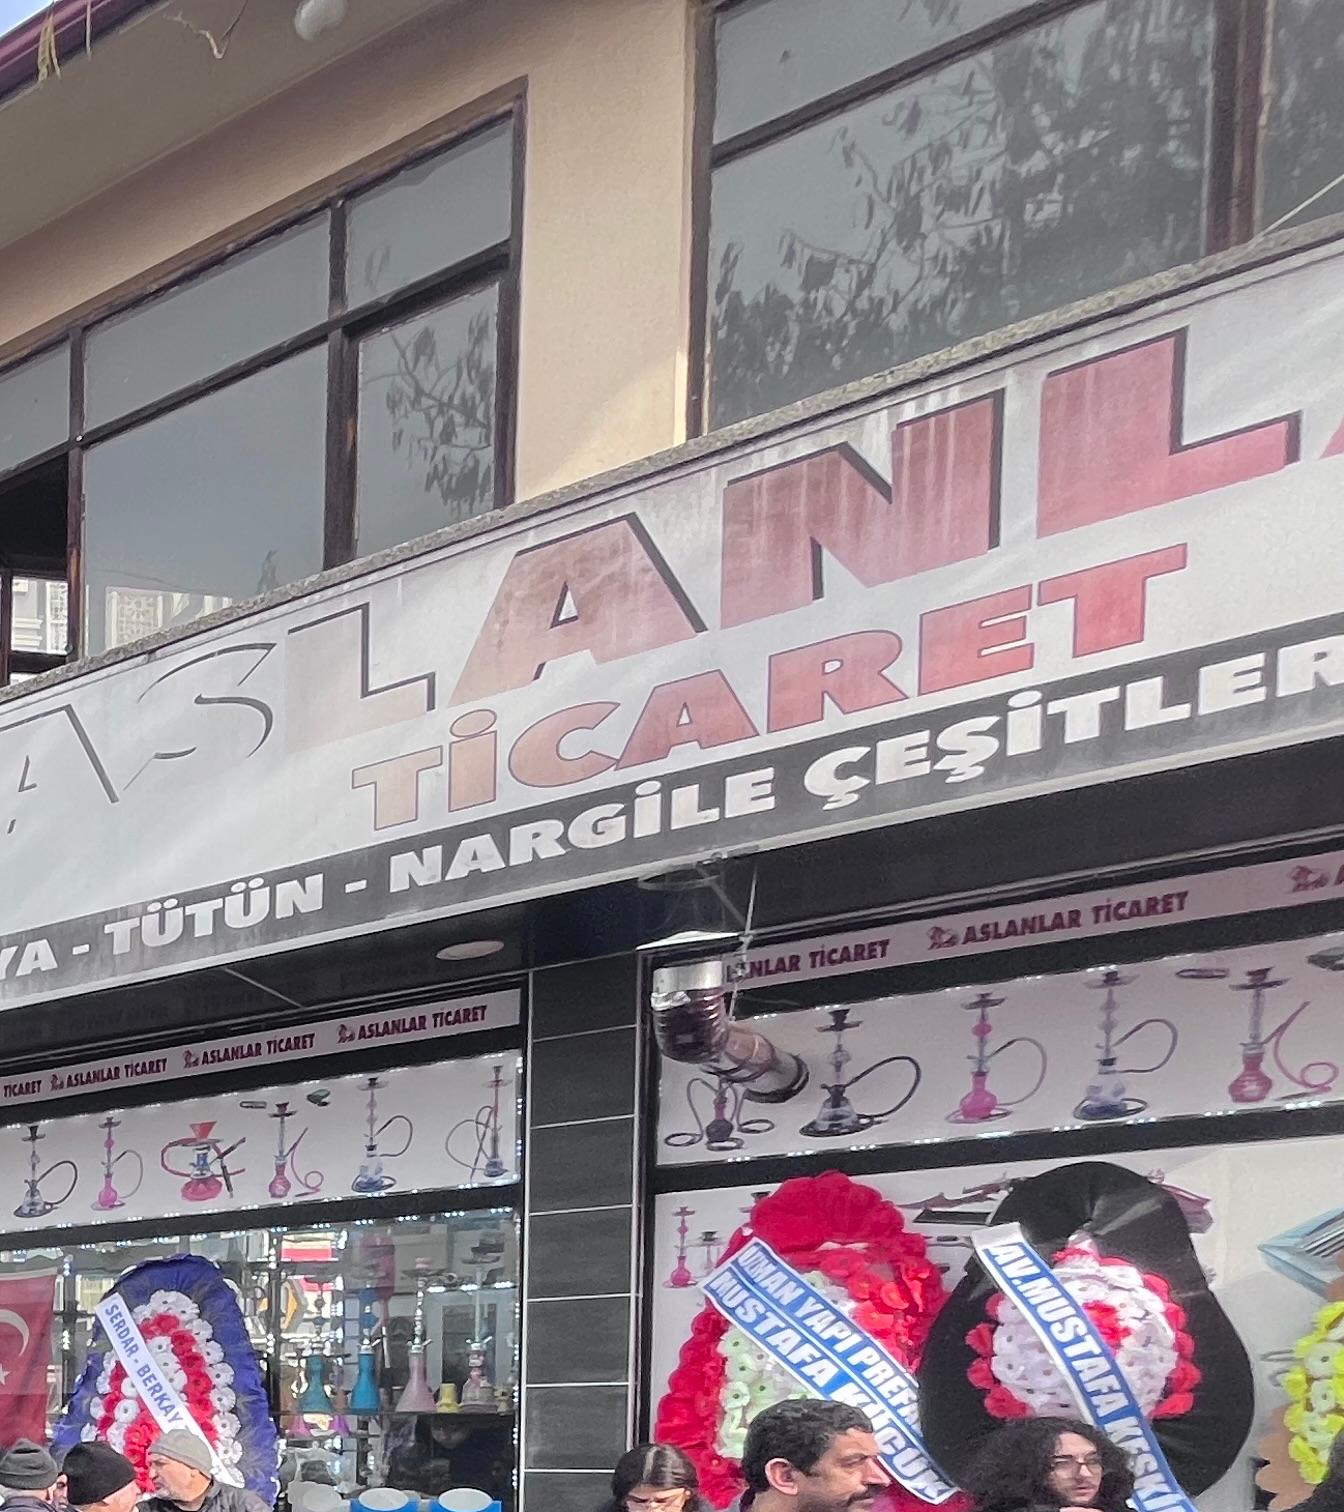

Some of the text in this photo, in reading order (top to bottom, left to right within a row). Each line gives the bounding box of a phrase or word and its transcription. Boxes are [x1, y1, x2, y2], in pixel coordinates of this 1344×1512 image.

[352, 542, 1188, 832] TİCARET
[104, 873, 325, 956] TÜTÜN
[390, 766, 777, 894] NARGİLE
[961, 891, 1189, 946] ASLANLAR TİCARET
[808, 939, 890, 969] TİCARET
[201, 1033, 316, 1066] ASLANLAR TİCARET
[357, 1004, 488, 1041] ASLANLAR TİCARET
[3, 1078, 43, 1099] TİCARET
[65, 1057, 168, 1090] ASLANLAR TİCARET
[707, 1271, 839, 1388] MUSTAFA
[794, 1296, 863, 1354] YAPI
[104, 1304, 140, 1358] SERDAR
[136, 1363, 184, 1424] BERKAY
